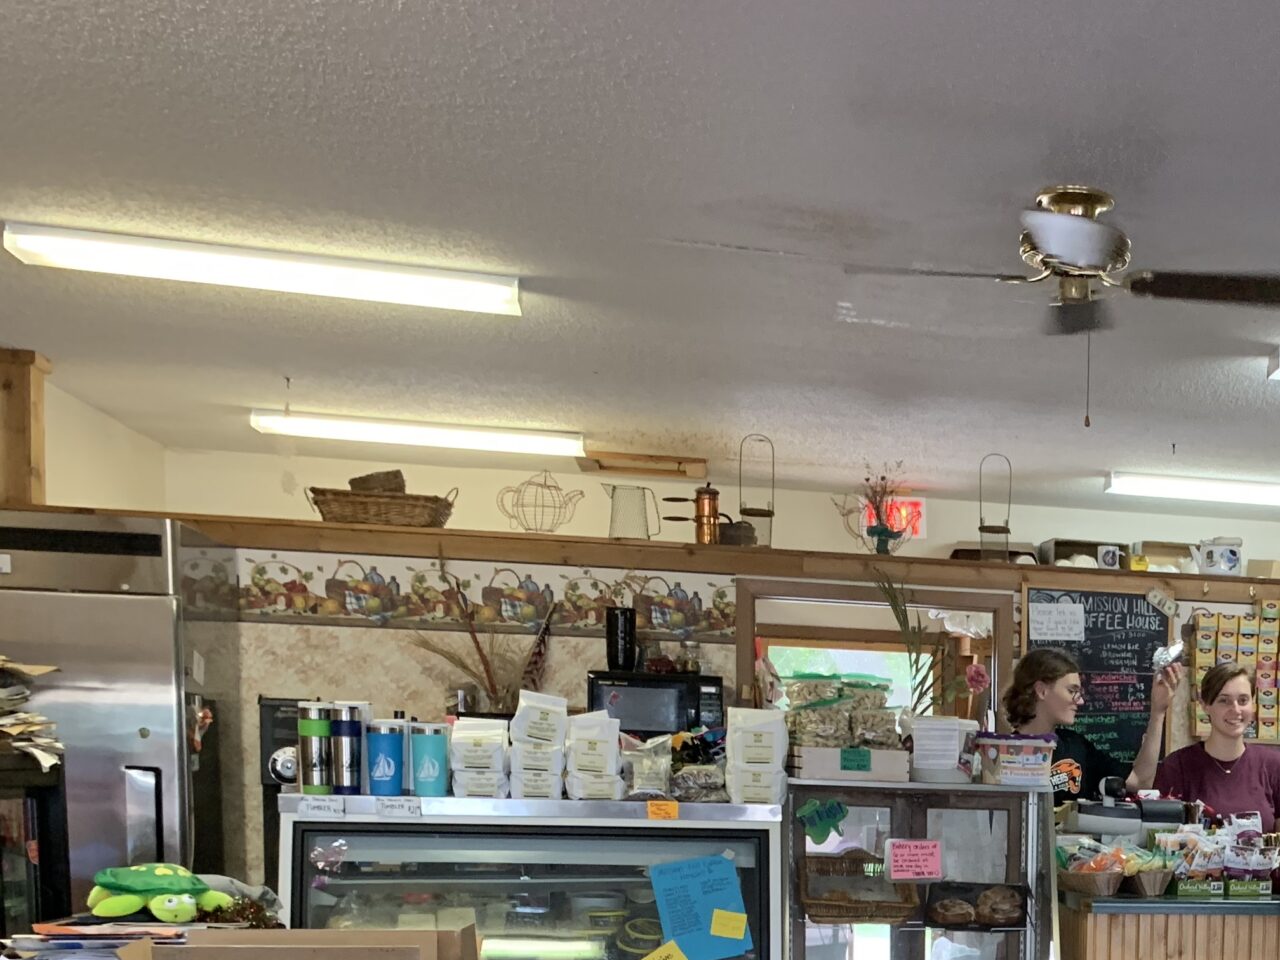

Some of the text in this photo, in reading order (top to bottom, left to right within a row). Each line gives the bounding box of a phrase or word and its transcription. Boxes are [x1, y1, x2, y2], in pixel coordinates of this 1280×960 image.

[1079, 594, 1157, 616] MISSION HILL
[1084, 612, 1123, 631] OFFEE
[1126, 615, 1165, 631] HOUSE
